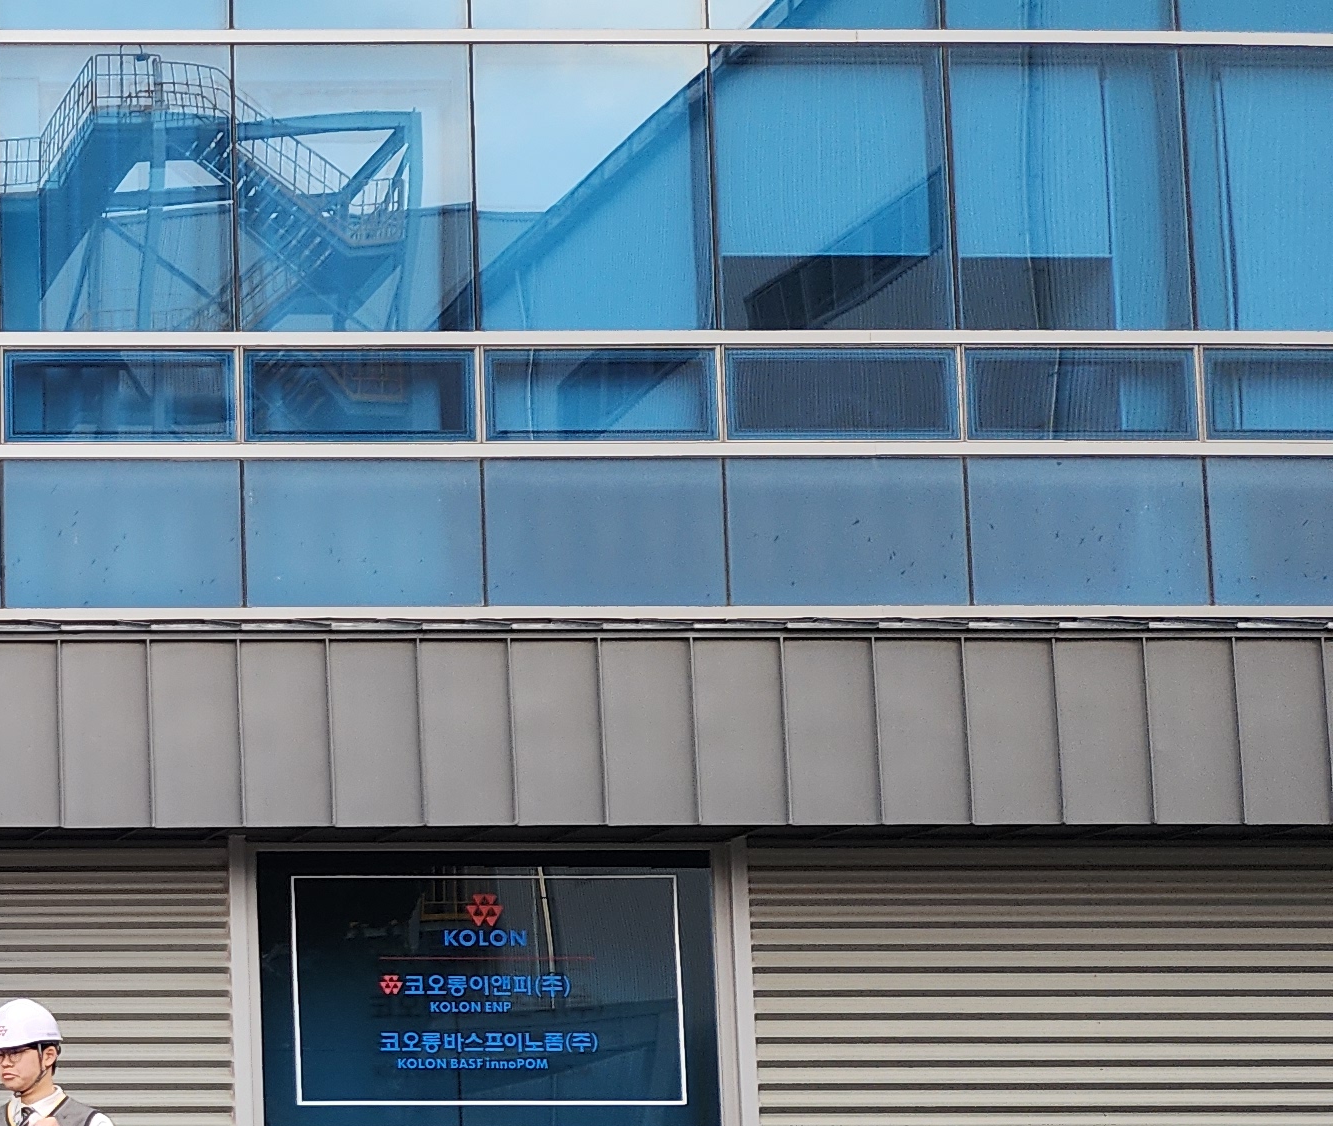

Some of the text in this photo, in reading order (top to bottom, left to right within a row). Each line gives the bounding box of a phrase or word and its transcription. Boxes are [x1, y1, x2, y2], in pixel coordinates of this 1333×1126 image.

[444, 929, 527, 947] KOLON
[404, 974, 571, 997] 코오롱이앤피(주)
[430, 1001, 512, 1013] KOLON ENP
[380, 1032, 598, 1053] 코오롱바스프이노폼(주)
[397, 1057, 549, 1069] KOLON BASF innoPOM
